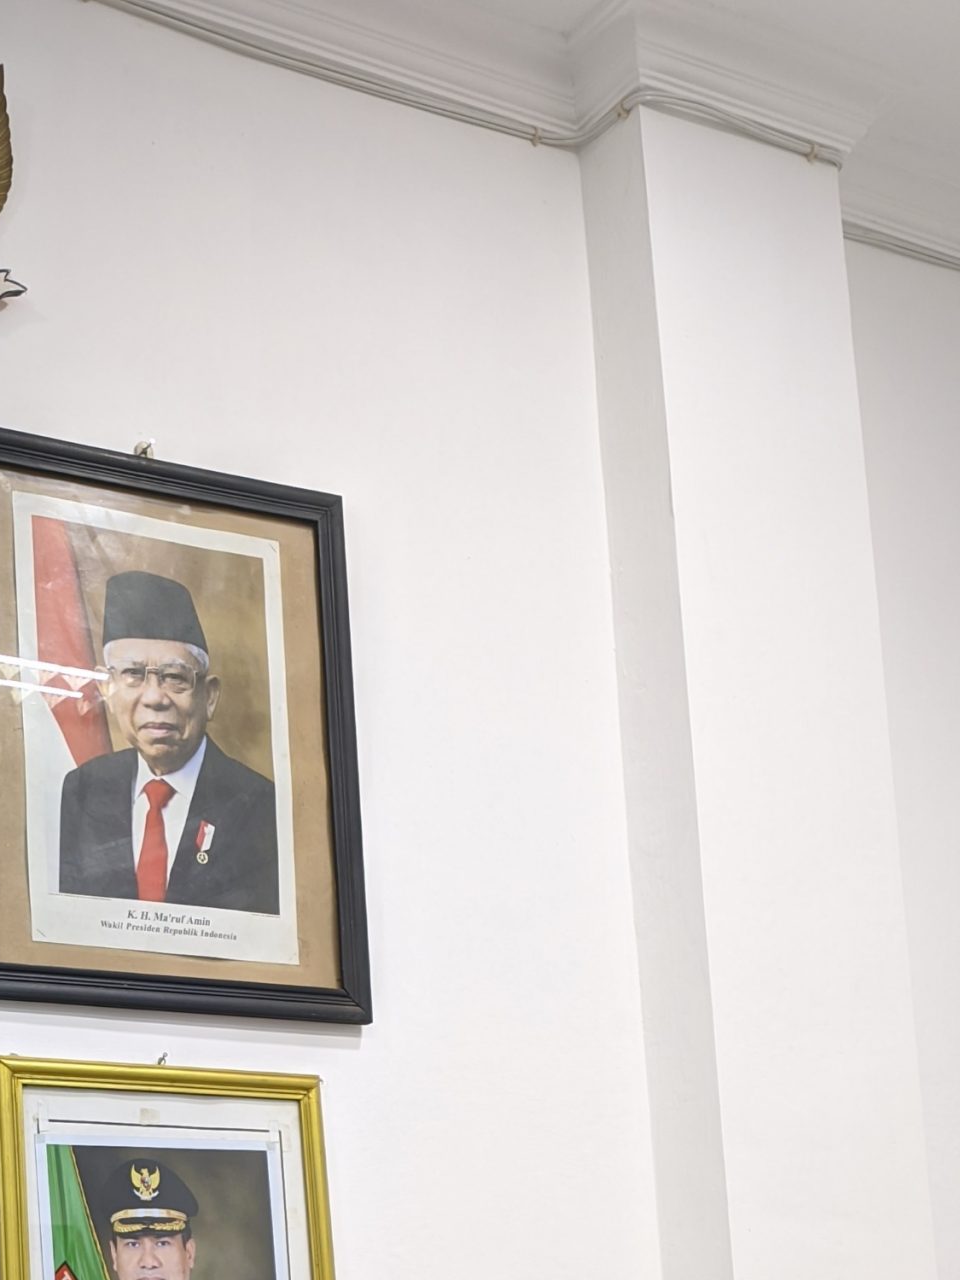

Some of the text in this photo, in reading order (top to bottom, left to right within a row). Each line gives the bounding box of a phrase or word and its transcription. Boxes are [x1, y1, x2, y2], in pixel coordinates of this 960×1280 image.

[127, 910, 211, 926] K. H. Ma'ruf Amin
[100, 920, 237, 941] Wakil Presiden Republik Indonesia
